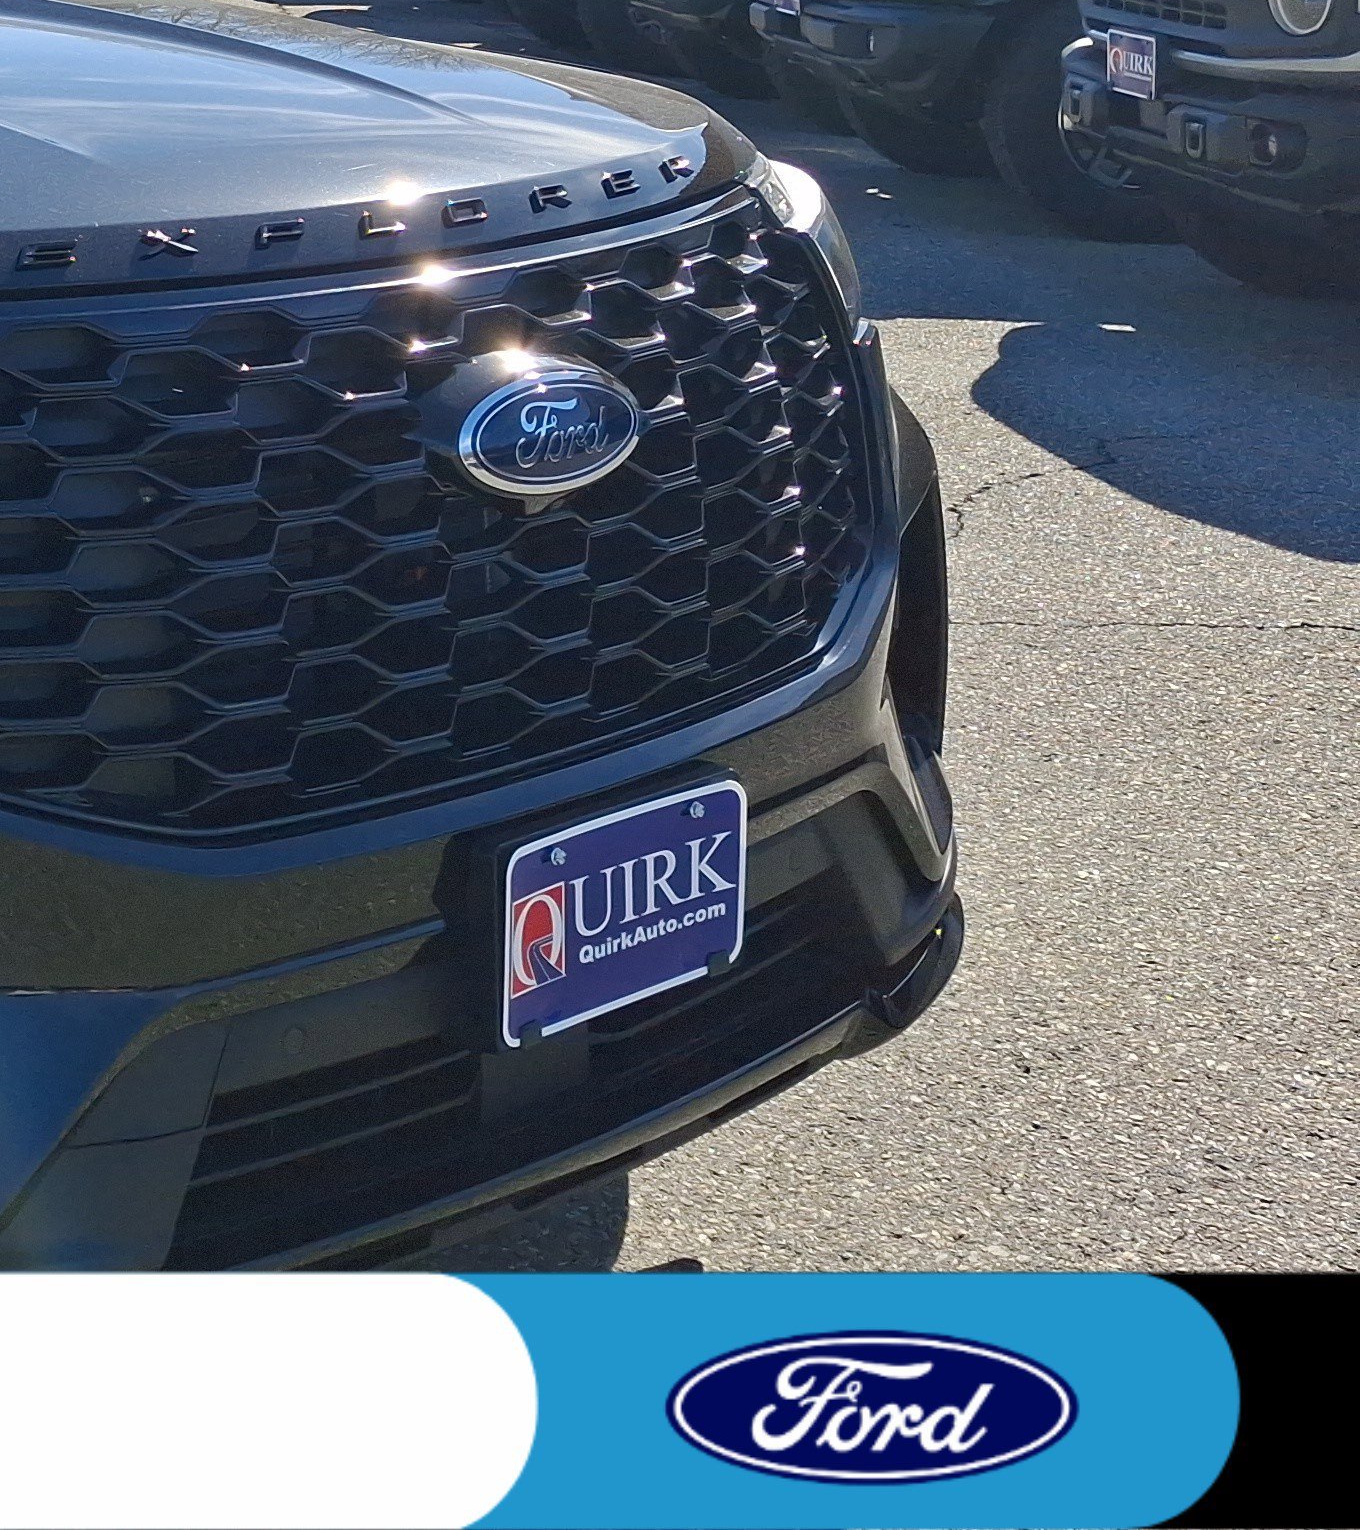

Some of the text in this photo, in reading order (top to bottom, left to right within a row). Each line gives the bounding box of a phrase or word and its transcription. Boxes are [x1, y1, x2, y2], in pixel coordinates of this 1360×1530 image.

[1109, 46, 1154, 76] QUIRK
[17, 154, 695, 270] EXPLORER
[515, 396, 610, 469] Ford
[512, 830, 737, 988] QUIRK
[579, 901, 726, 964] QuirkAuto.com
